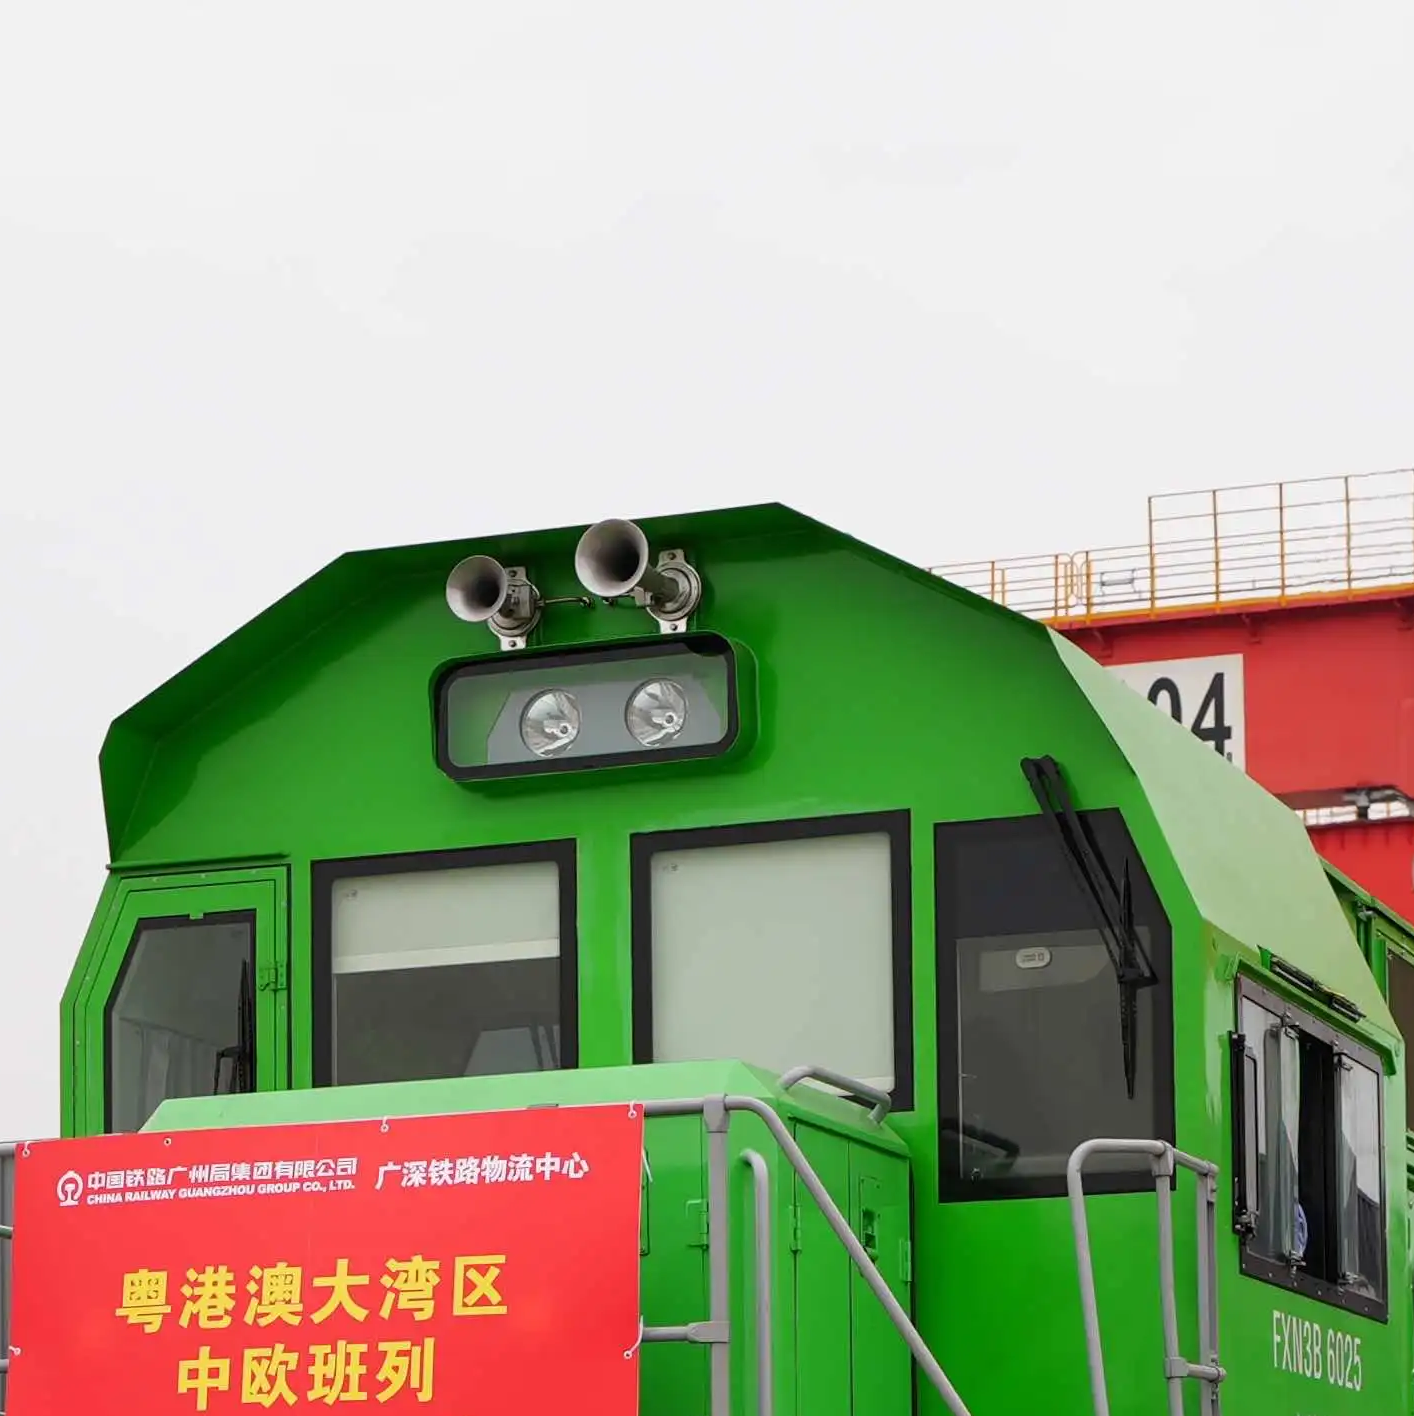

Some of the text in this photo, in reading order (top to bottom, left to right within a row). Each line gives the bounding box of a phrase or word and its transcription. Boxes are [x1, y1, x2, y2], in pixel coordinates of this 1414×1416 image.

[87, 1152, 589, 1190] 中国铁路广州局集团有限公司 广深铁路物流中心
[87, 1192, 123, 1205] CHINA
[125, 1187, 175, 1203] RAILWAY
[178, 1183, 256, 1199] GUANGZHOU
[258, 1181, 301, 1196] GROUP
[329, 1177, 355, 1192] LTD.
[115, 1255, 508, 1334] 粤港澳大湾区
[177, 1337, 435, 1411] 中欧班列
[1273, 1310, 1362, 1391] FXN3B 6025
